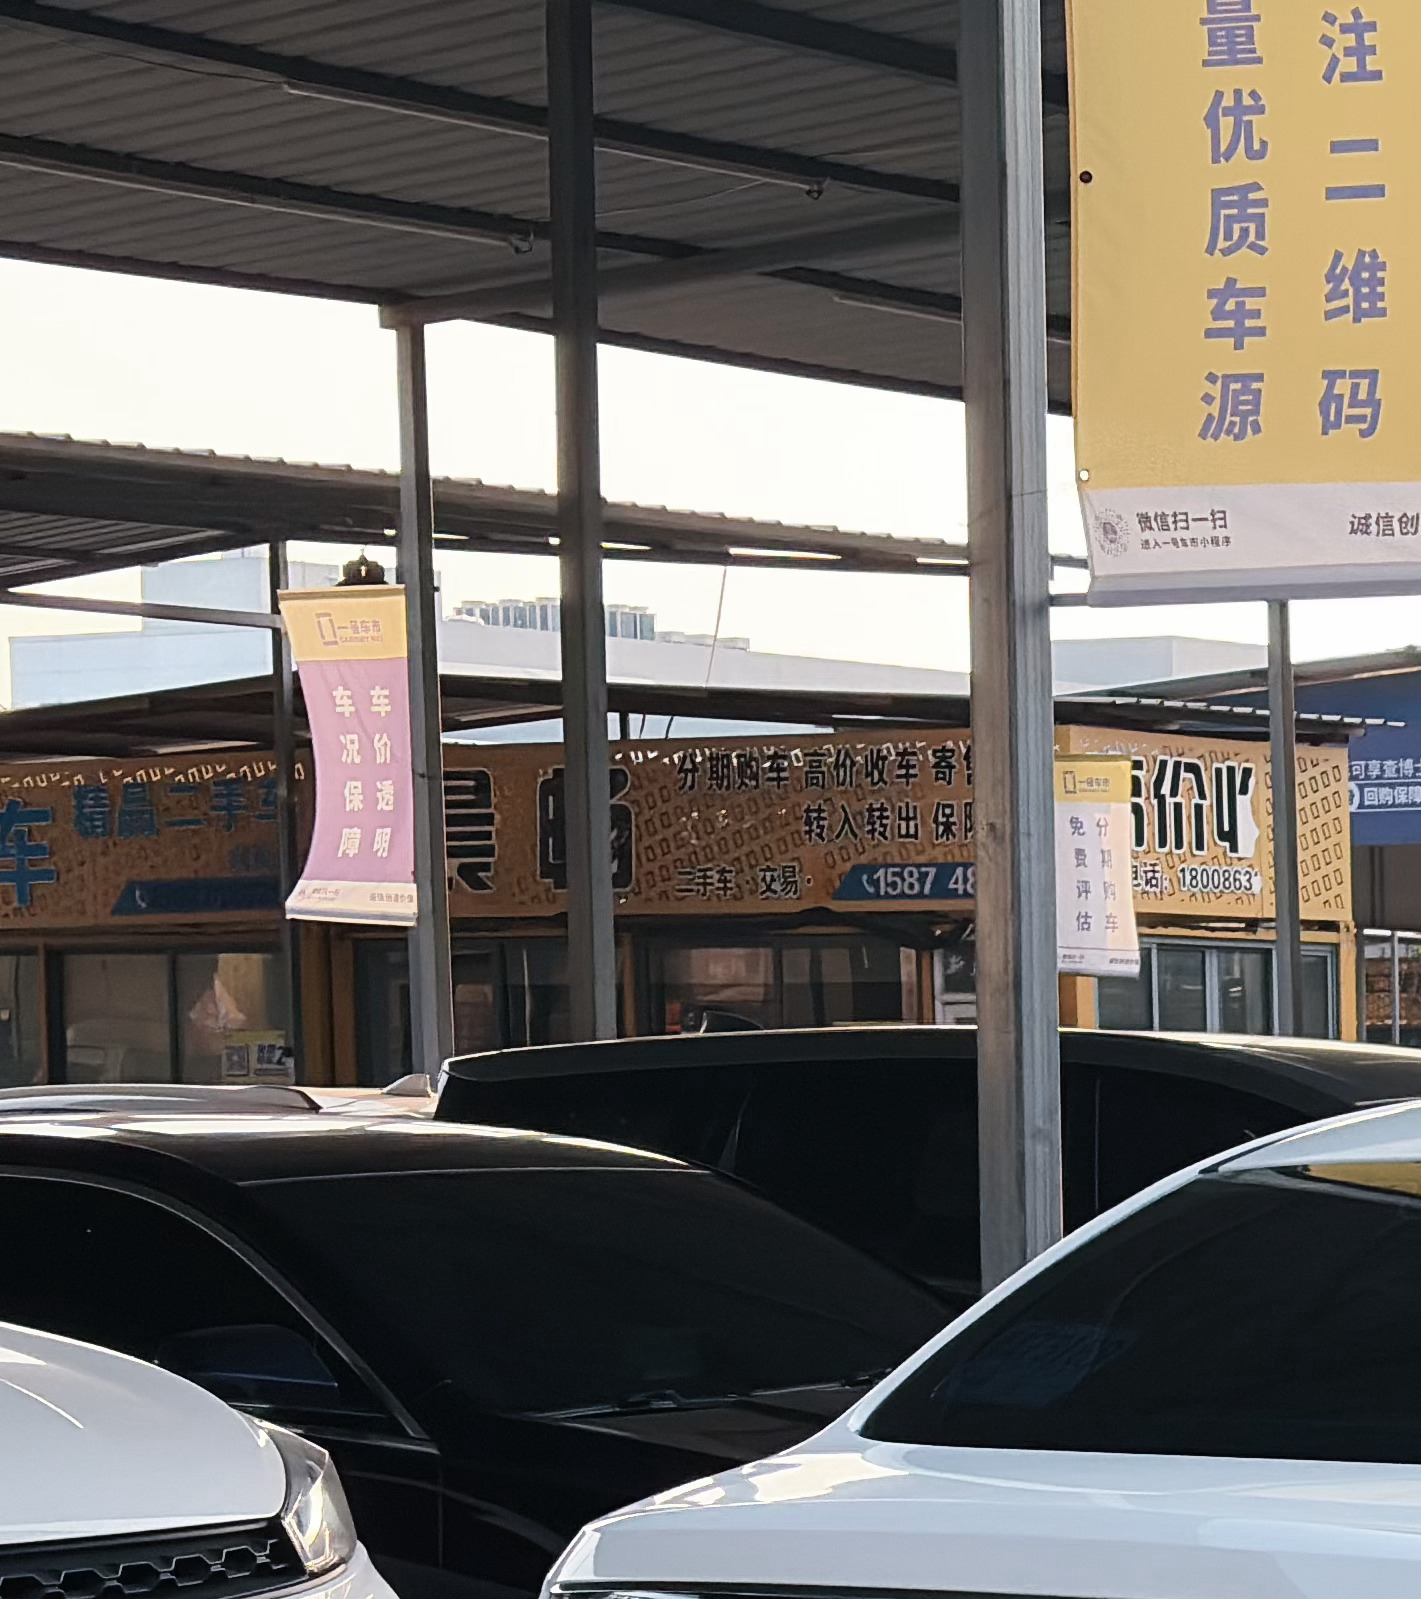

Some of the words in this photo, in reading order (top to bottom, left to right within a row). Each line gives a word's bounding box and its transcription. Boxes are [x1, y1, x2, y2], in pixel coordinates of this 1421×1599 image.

[1317, 7, 1388, 439] 注二维码
[1136, 508, 1228, 533] 微信扫一扫
[332, 685, 364, 858] 车况保障
[370, 685, 394, 858] 车价透明
[803, 747, 919, 791] 高价收车
[803, 801, 919, 843] 转入转出
[875, 866, 937, 896] 1587
[1069, 815, 1092, 932] 免费评估
